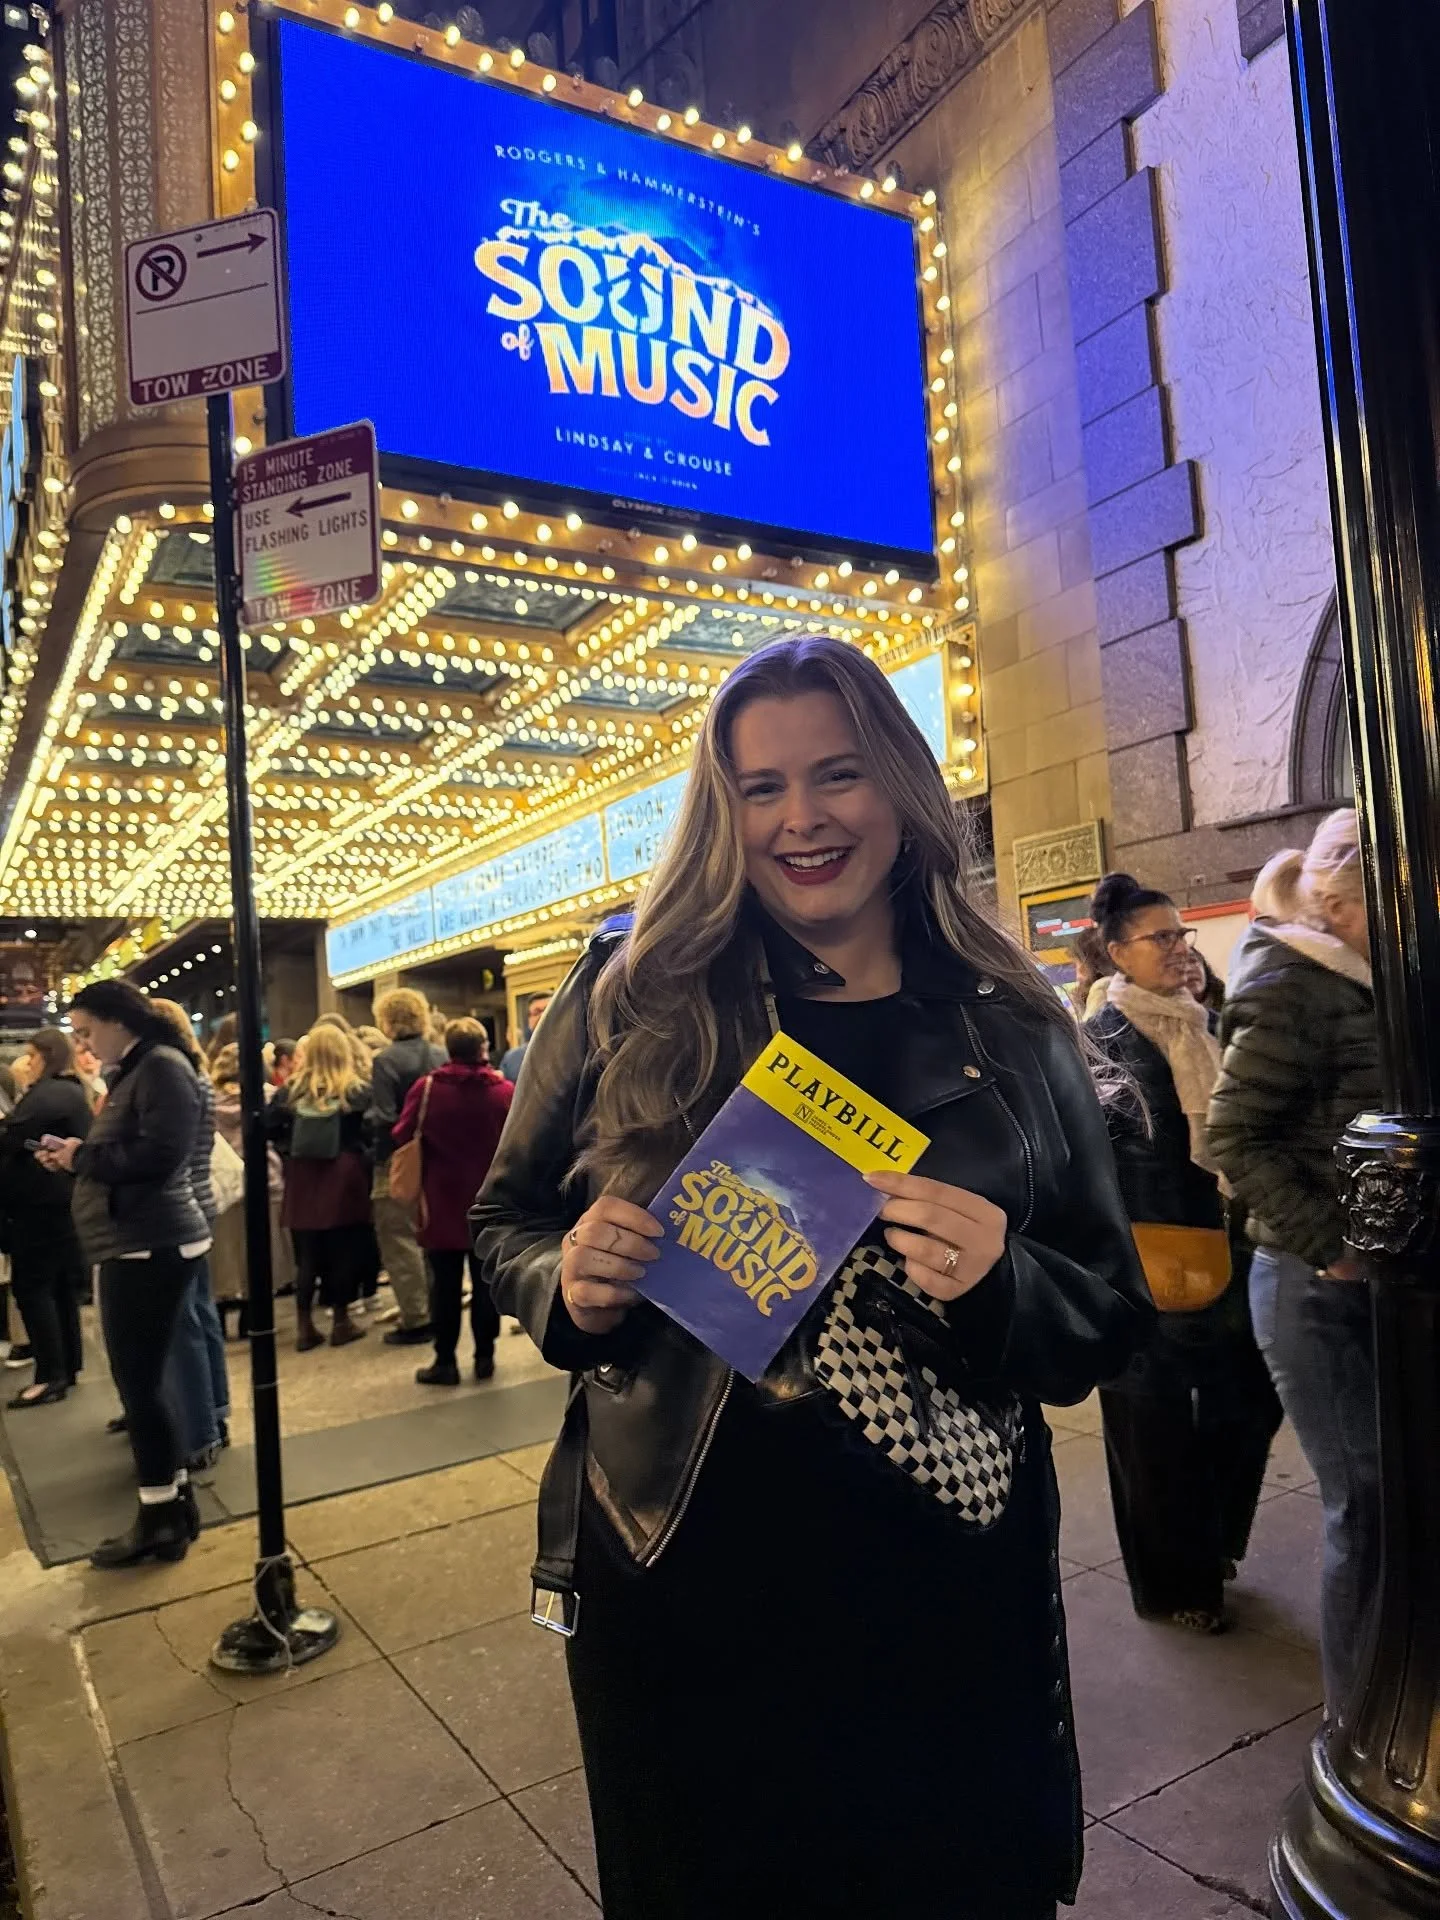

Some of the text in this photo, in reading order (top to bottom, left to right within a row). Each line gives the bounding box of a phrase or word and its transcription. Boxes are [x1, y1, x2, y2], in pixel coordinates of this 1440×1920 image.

[494, 144, 760, 236] RODGERS & HAMMERSTEIN'S
[500, 198, 574, 228] The
[474, 239, 790, 380] SOUND
[139, 357, 270, 402] TOW ZONE
[500, 322, 779, 446] of MUSIC
[241, 447, 315, 483] 15 MINUTE
[555, 426, 634, 456] LINDSAY
[643, 447, 654, 460] &
[663, 450, 733, 477] CROUSE
[242, 458, 353, 502] STANDING ZONE
[244, 508, 271, 529] USE
[245, 509, 368, 554] FLASHING LIGHTS
[255, 579, 362, 621] TOW ZONE
[609, 793, 665, 840] LONDON
[577, 856, 603, 884] TWO
[766, 1051, 905, 1163] PLAYBILL
[710, 1160, 742, 1185] The
[672, 1171, 818, 1291] SOUND
[669, 1210, 792, 1318] of MUSIC
